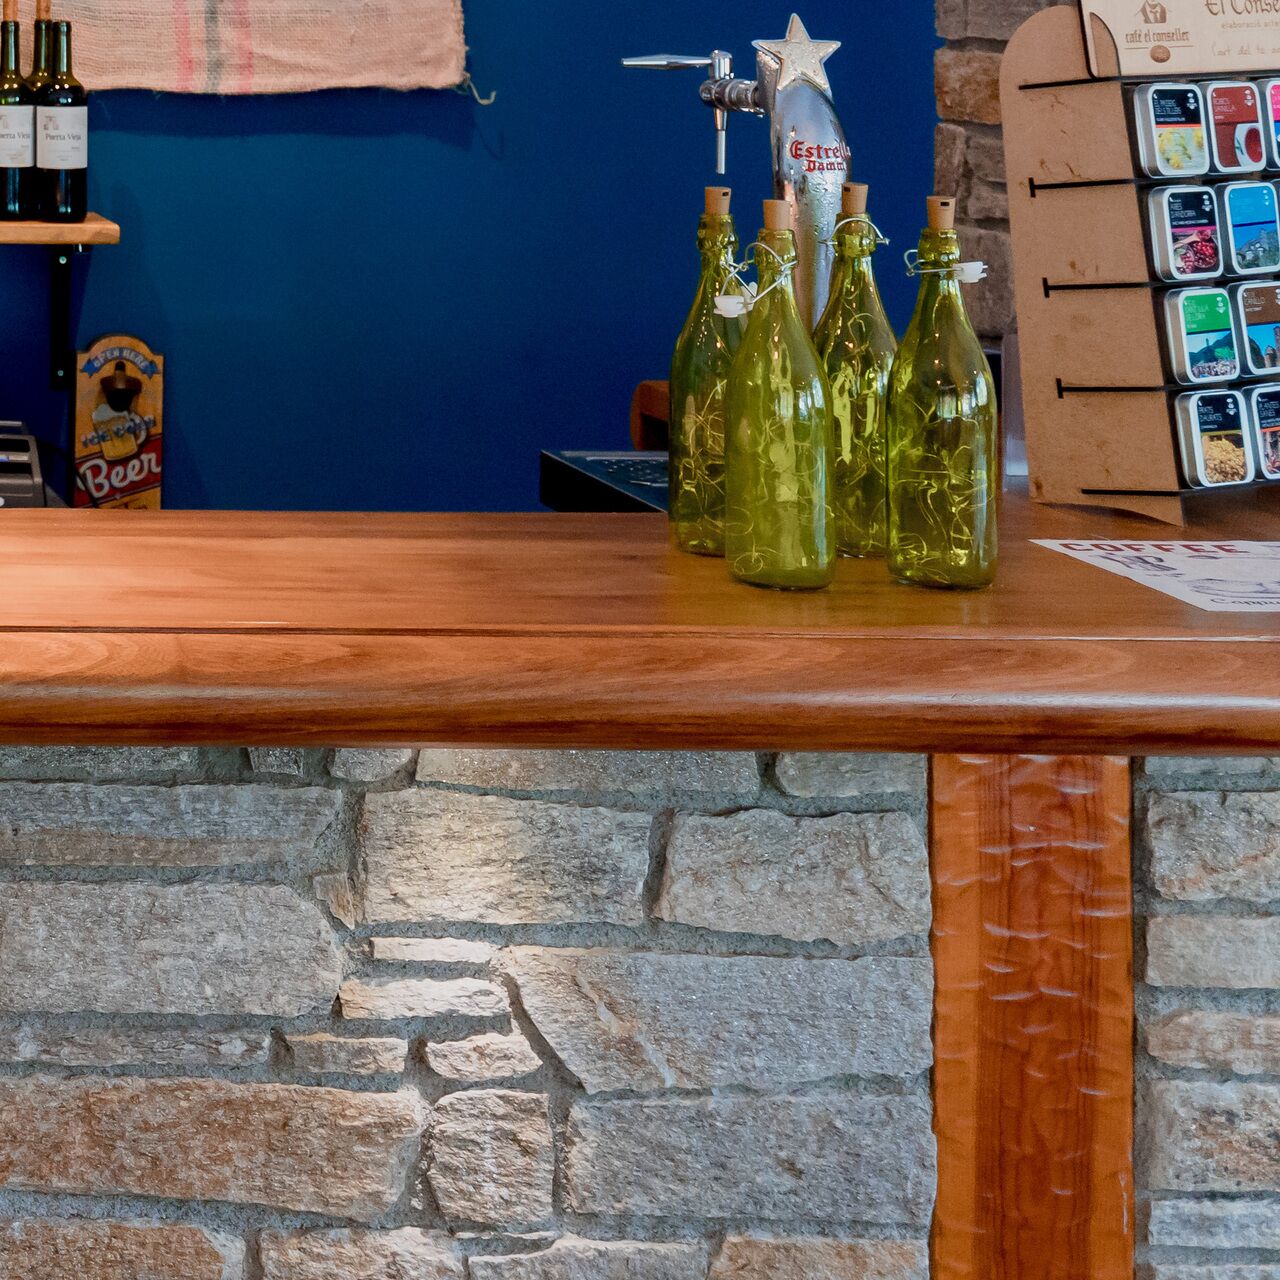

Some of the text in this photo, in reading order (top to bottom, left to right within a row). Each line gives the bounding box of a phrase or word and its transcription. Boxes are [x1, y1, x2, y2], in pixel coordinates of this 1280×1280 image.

[93, 348, 120, 369] OPEN
[76, 452, 162, 498] Beer
[1059, 543, 1250, 554] COFFEE
